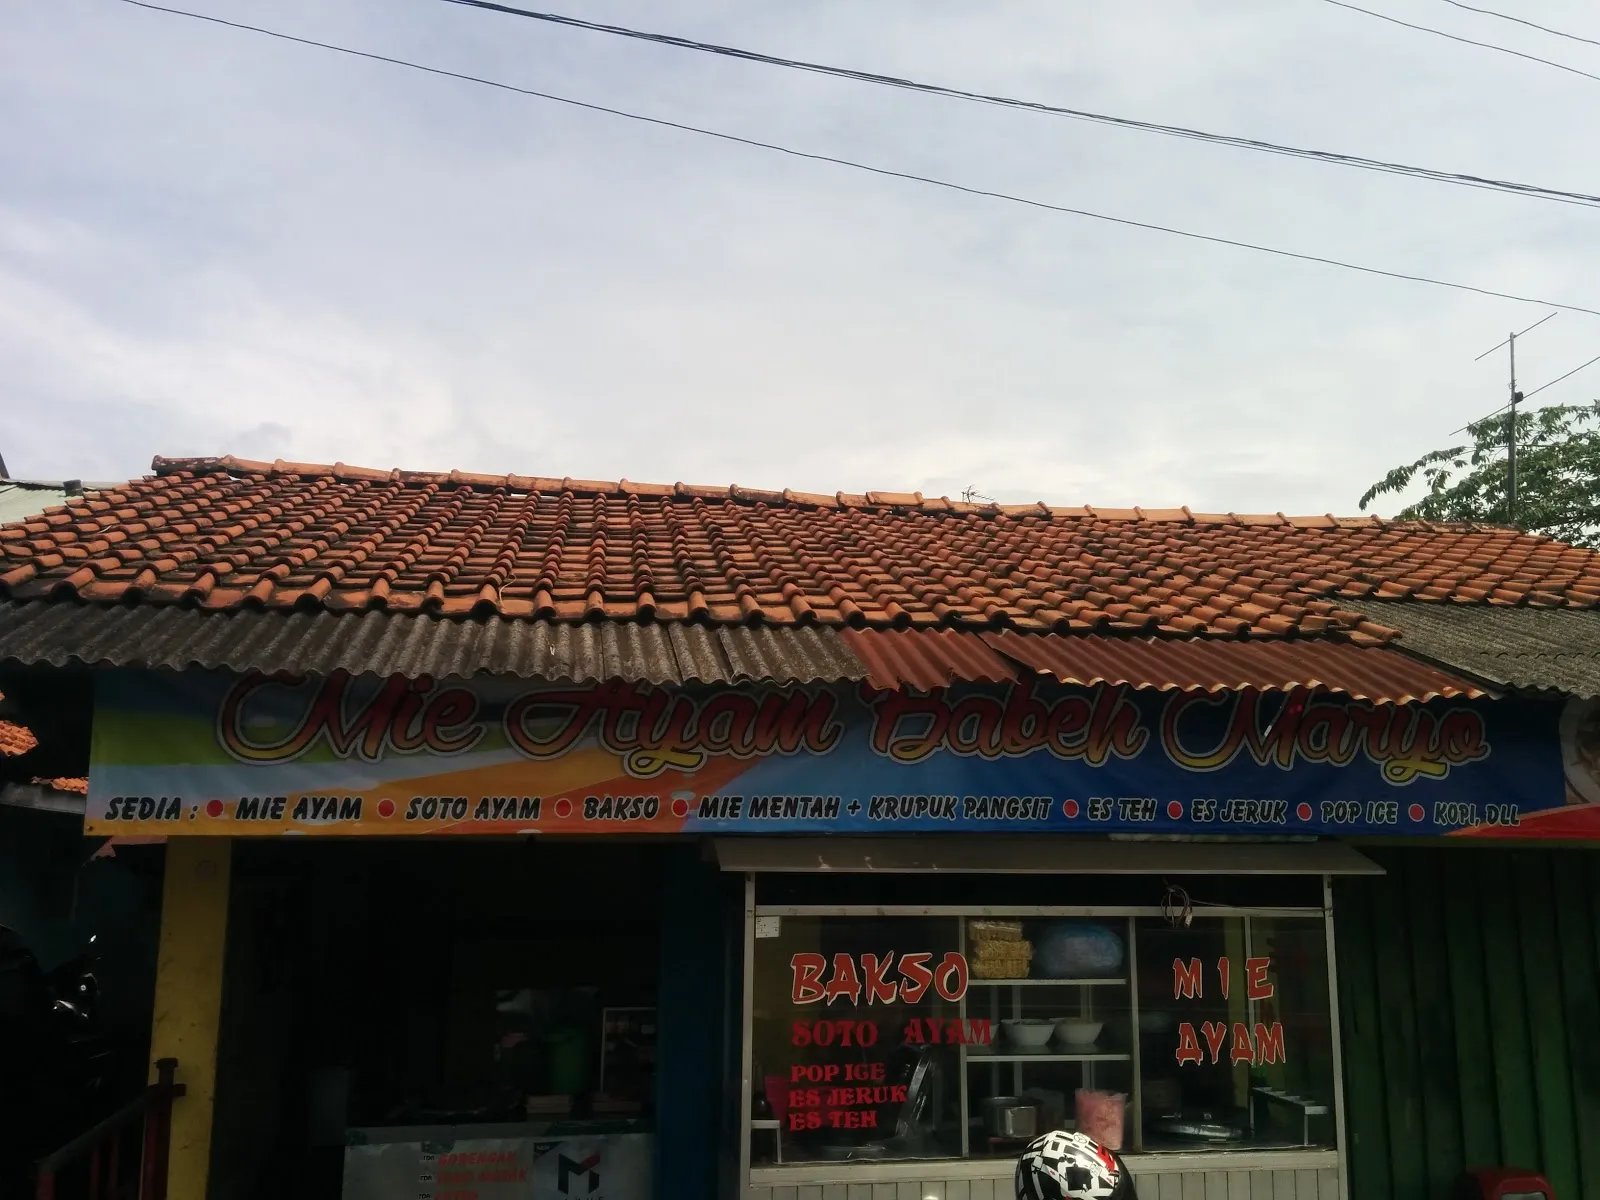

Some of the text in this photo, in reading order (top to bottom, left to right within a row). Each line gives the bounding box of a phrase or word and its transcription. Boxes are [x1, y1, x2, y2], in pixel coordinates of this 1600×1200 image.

[217, 668, 1491, 786] Mie Ayam Babeh Maryo
[105, 797, 181, 821] SEDIA
[235, 797, 287, 821] MIE
[292, 797, 362, 821] AYAM
[405, 797, 467, 821] SOTO
[474, 797, 541, 821] AYAM
[582, 797, 659, 820] BAKSO
[698, 797, 741, 820] MIE
[748, 796, 840, 820] MENTAH
[868, 796, 958, 821] KRUPUK
[963, 796, 1053, 821] PANGSIT
[1087, 797, 1112, 822] ES
[1117, 798, 1158, 821] TEH
[1191, 799, 1217, 823] ES
[1219, 799, 1288, 824] JERUK
[1320, 801, 1362, 825] POP
[1366, 801, 1399, 825] ICE
[1485, 803, 1521, 827] DLL
[790, 951, 969, 1007] BAKSO
[1172, 956, 1275, 1000] MIE
[791, 1017, 992, 1048] SOTO AYAM
[1175, 1020, 1287, 1067] AYAM
[791, 1062, 886, 1083] POP ICE
[788, 1084, 908, 1109] ES JERUK
[788, 1109, 878, 1132] ES TEH
